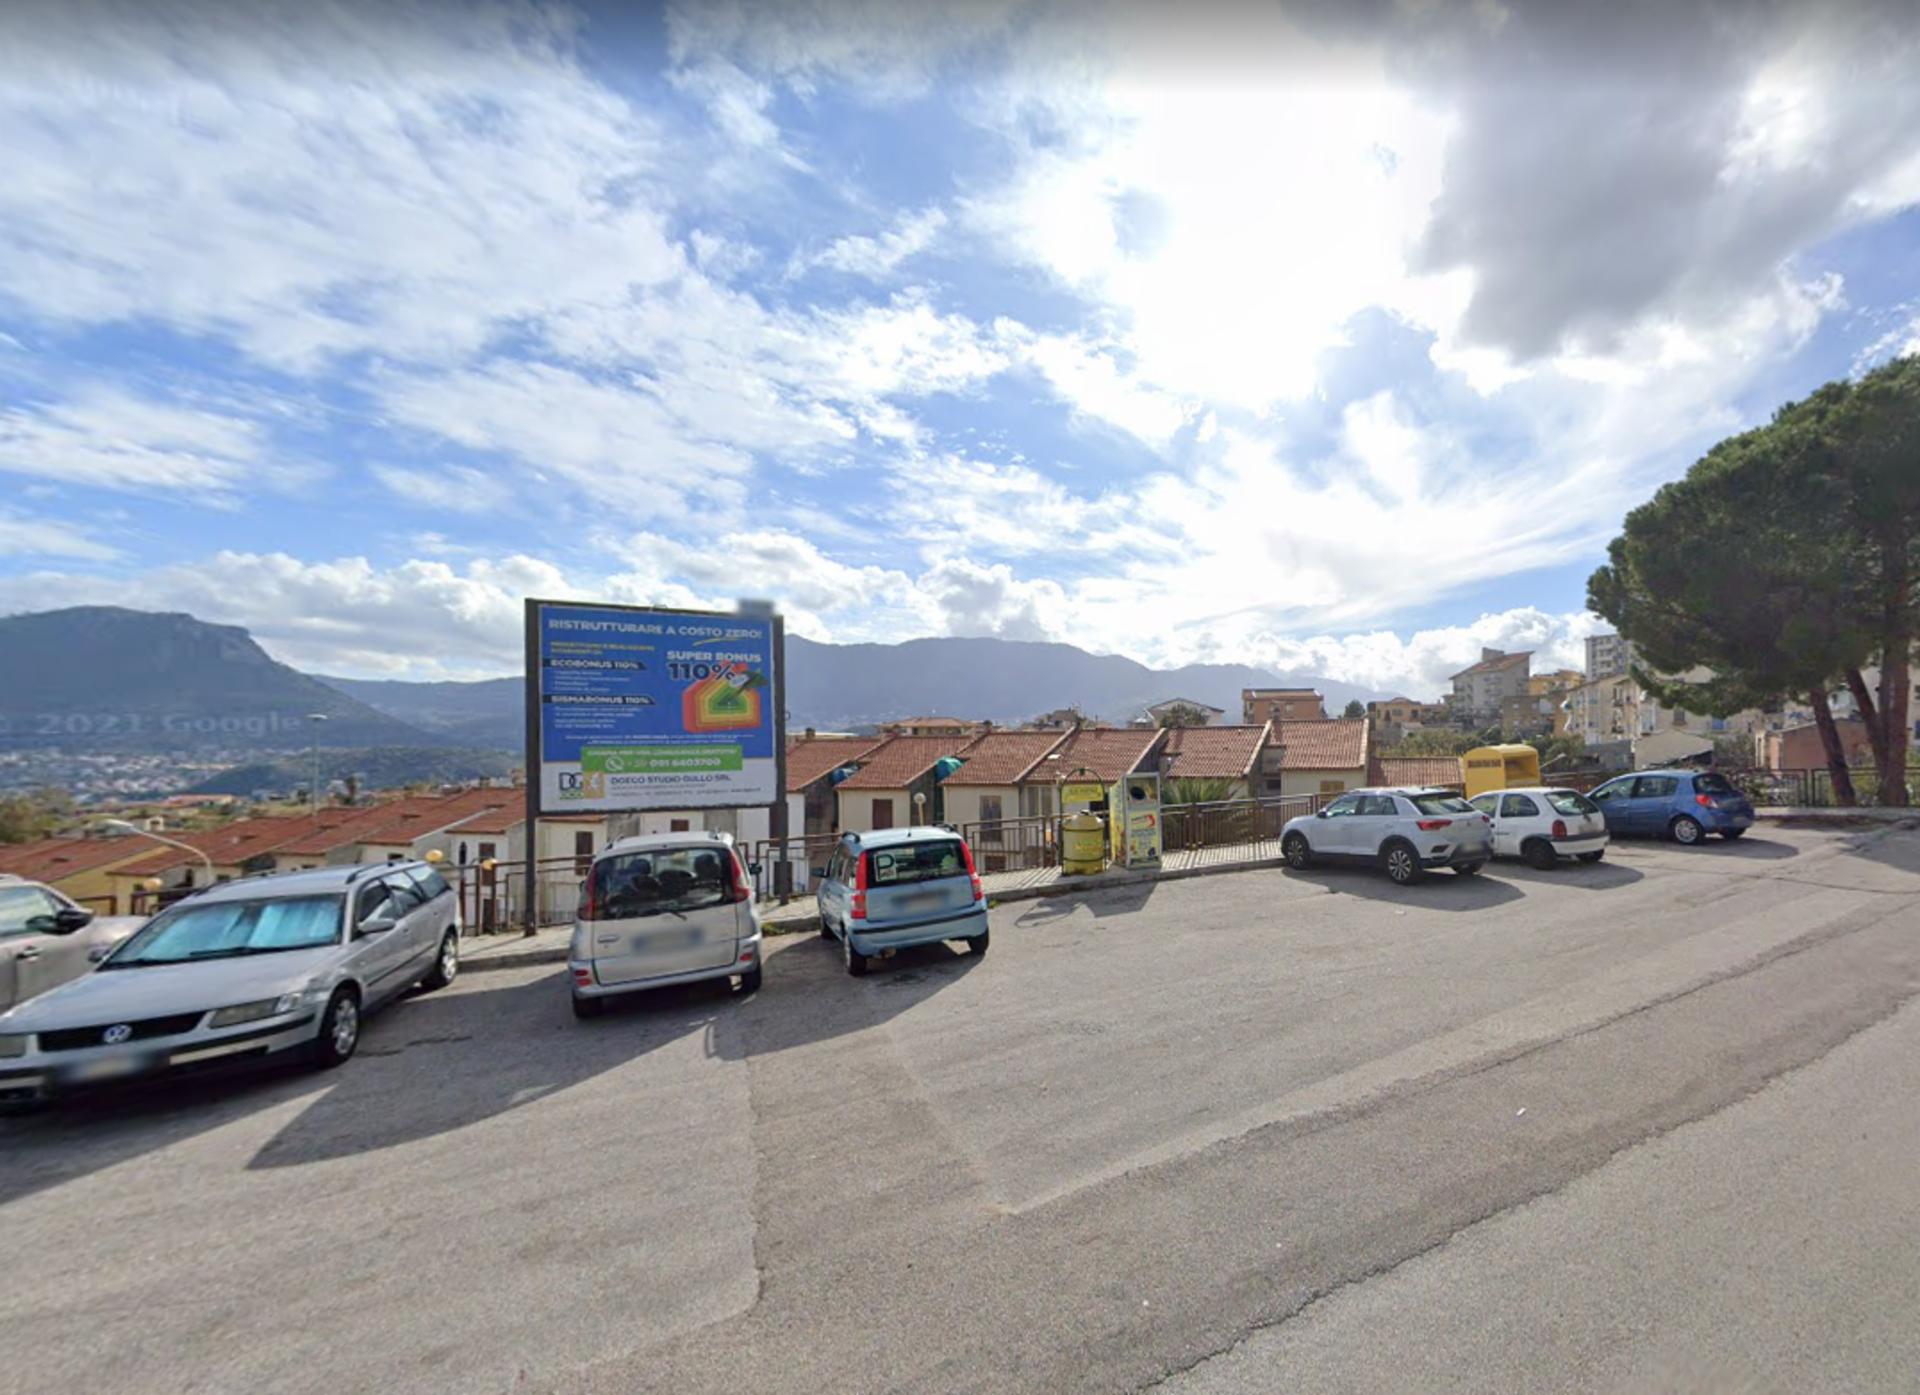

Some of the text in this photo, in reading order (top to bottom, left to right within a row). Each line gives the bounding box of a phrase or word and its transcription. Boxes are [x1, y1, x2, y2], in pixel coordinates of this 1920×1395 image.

[549, 619, 762, 639] RISTRUTTURARE A COSTO ZERO!
[667, 650, 761, 662] SUPER BONUS
[551, 659, 612, 669] ECOBONUS
[668, 663, 735, 680] 110%
